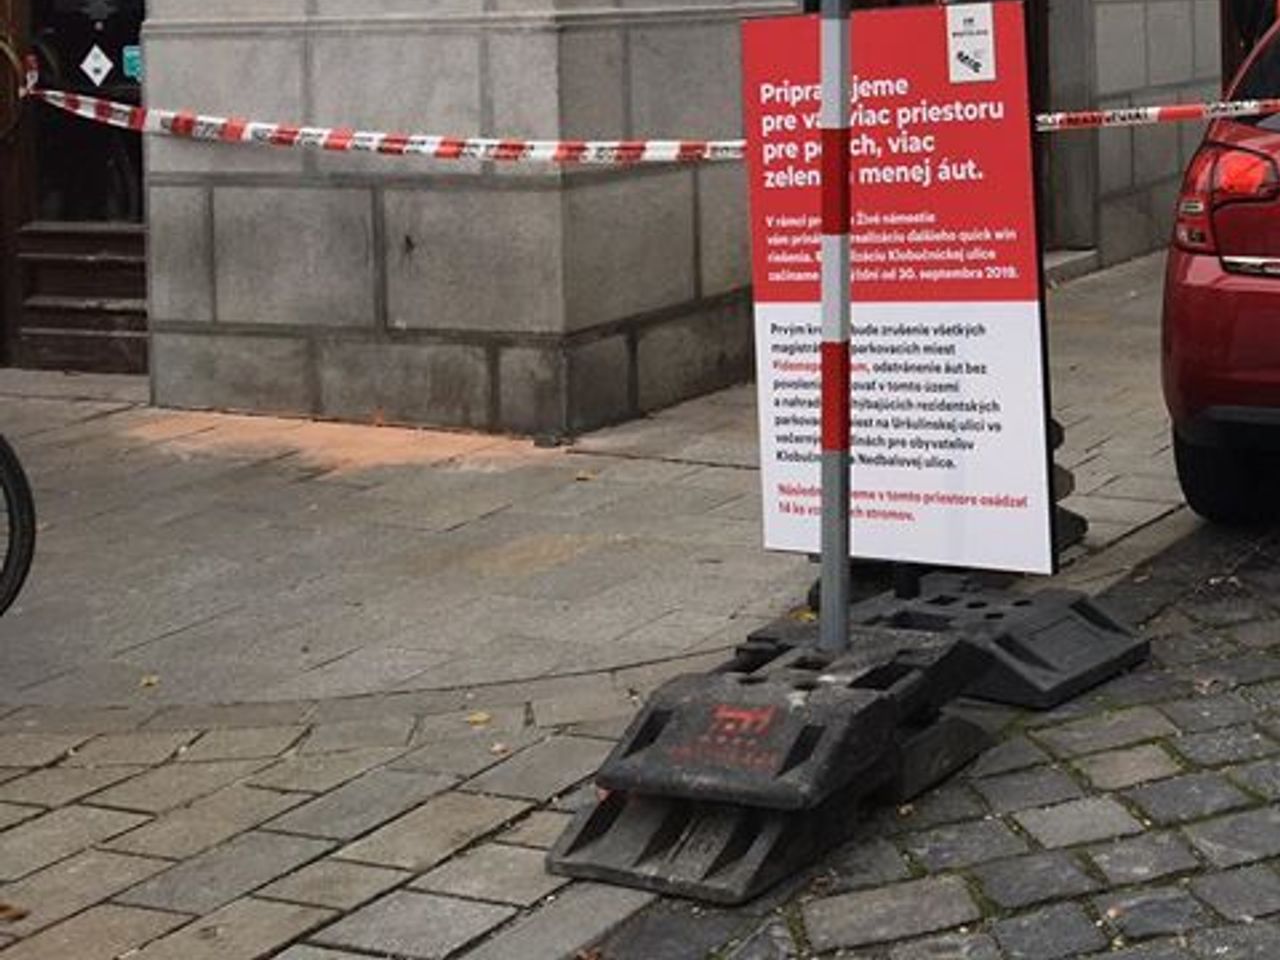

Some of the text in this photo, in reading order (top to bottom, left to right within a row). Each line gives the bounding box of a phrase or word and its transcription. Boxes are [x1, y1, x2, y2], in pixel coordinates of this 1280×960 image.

[761, 75, 908, 107] Priprajeme
[762, 113, 797, 137] pre
[897, 98, 1004, 130] priestoru
[763, 141, 798, 165] pre
[888, 131, 935, 154] viac
[764, 157, 984, 188] zelen menej áut.
